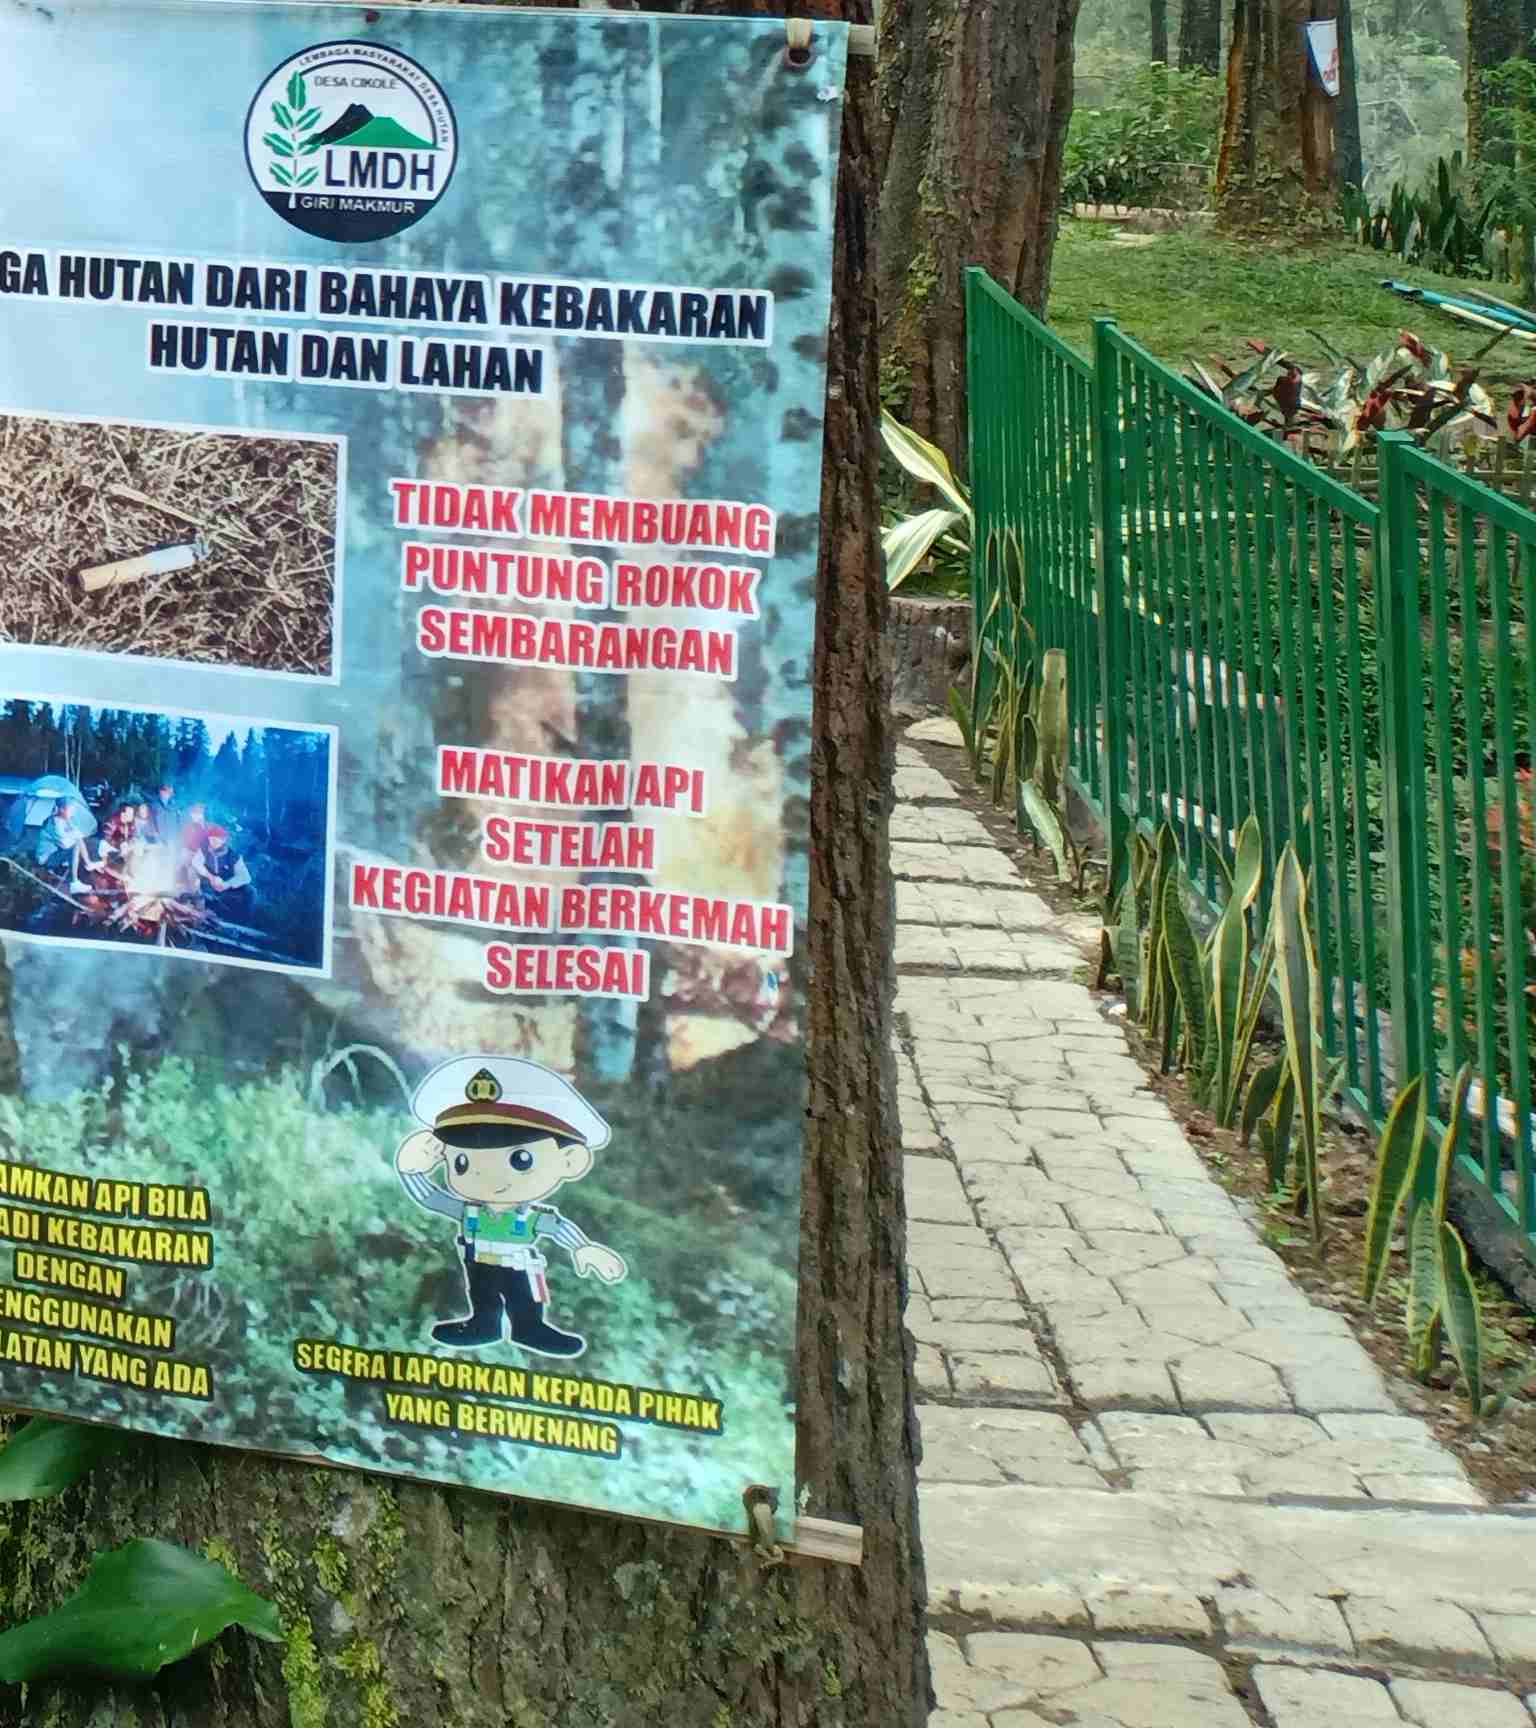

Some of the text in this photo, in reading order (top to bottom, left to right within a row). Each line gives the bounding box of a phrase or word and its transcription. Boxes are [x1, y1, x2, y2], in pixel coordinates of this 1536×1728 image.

[298, 48, 449, 143] LEMBAGA MASYARAKAT DESA HUTAN
[314, 77, 399, 90] DESA CIKOLE
[325, 149, 436, 192] LMDH
[300, 196, 416, 214] GIRI MAKMUR
[59, 254, 195, 305] HUTAN
[206, 263, 307, 313] DARI
[320, 270, 488, 325] BAHAYA
[499, 281, 768, 340] KEBAKARAN
[150, 323, 544, 394] HUTAN DAN LAHAN
[391, 482, 772, 552] TIDAK MEMBUANG
[404, 545, 758, 615] PUNTUNG ROKOK
[420, 608, 733, 676] SEMBARANGAN
[440, 749, 705, 814] MATIKAN API
[485, 817, 655, 869] SETELAH
[352, 864, 789, 952] KEGIATAN BERKEMAH
[486, 944, 645, 996] SELESAI
[94, 1182, 141, 1216] API
[148, 1187, 208, 1221] BILA
[47, 1216, 210, 1266] KEBAKARAN
[17, 1251, 123, 1298] DENGAN
[79, 1344, 147, 1387] YANG
[153, 1360, 209, 1397] ADA
[296, 1342, 720, 1430] SEGERA LAPORKAN KEPADA PIHAK
[385, 1393, 618, 1455] YANG BERWENANG
